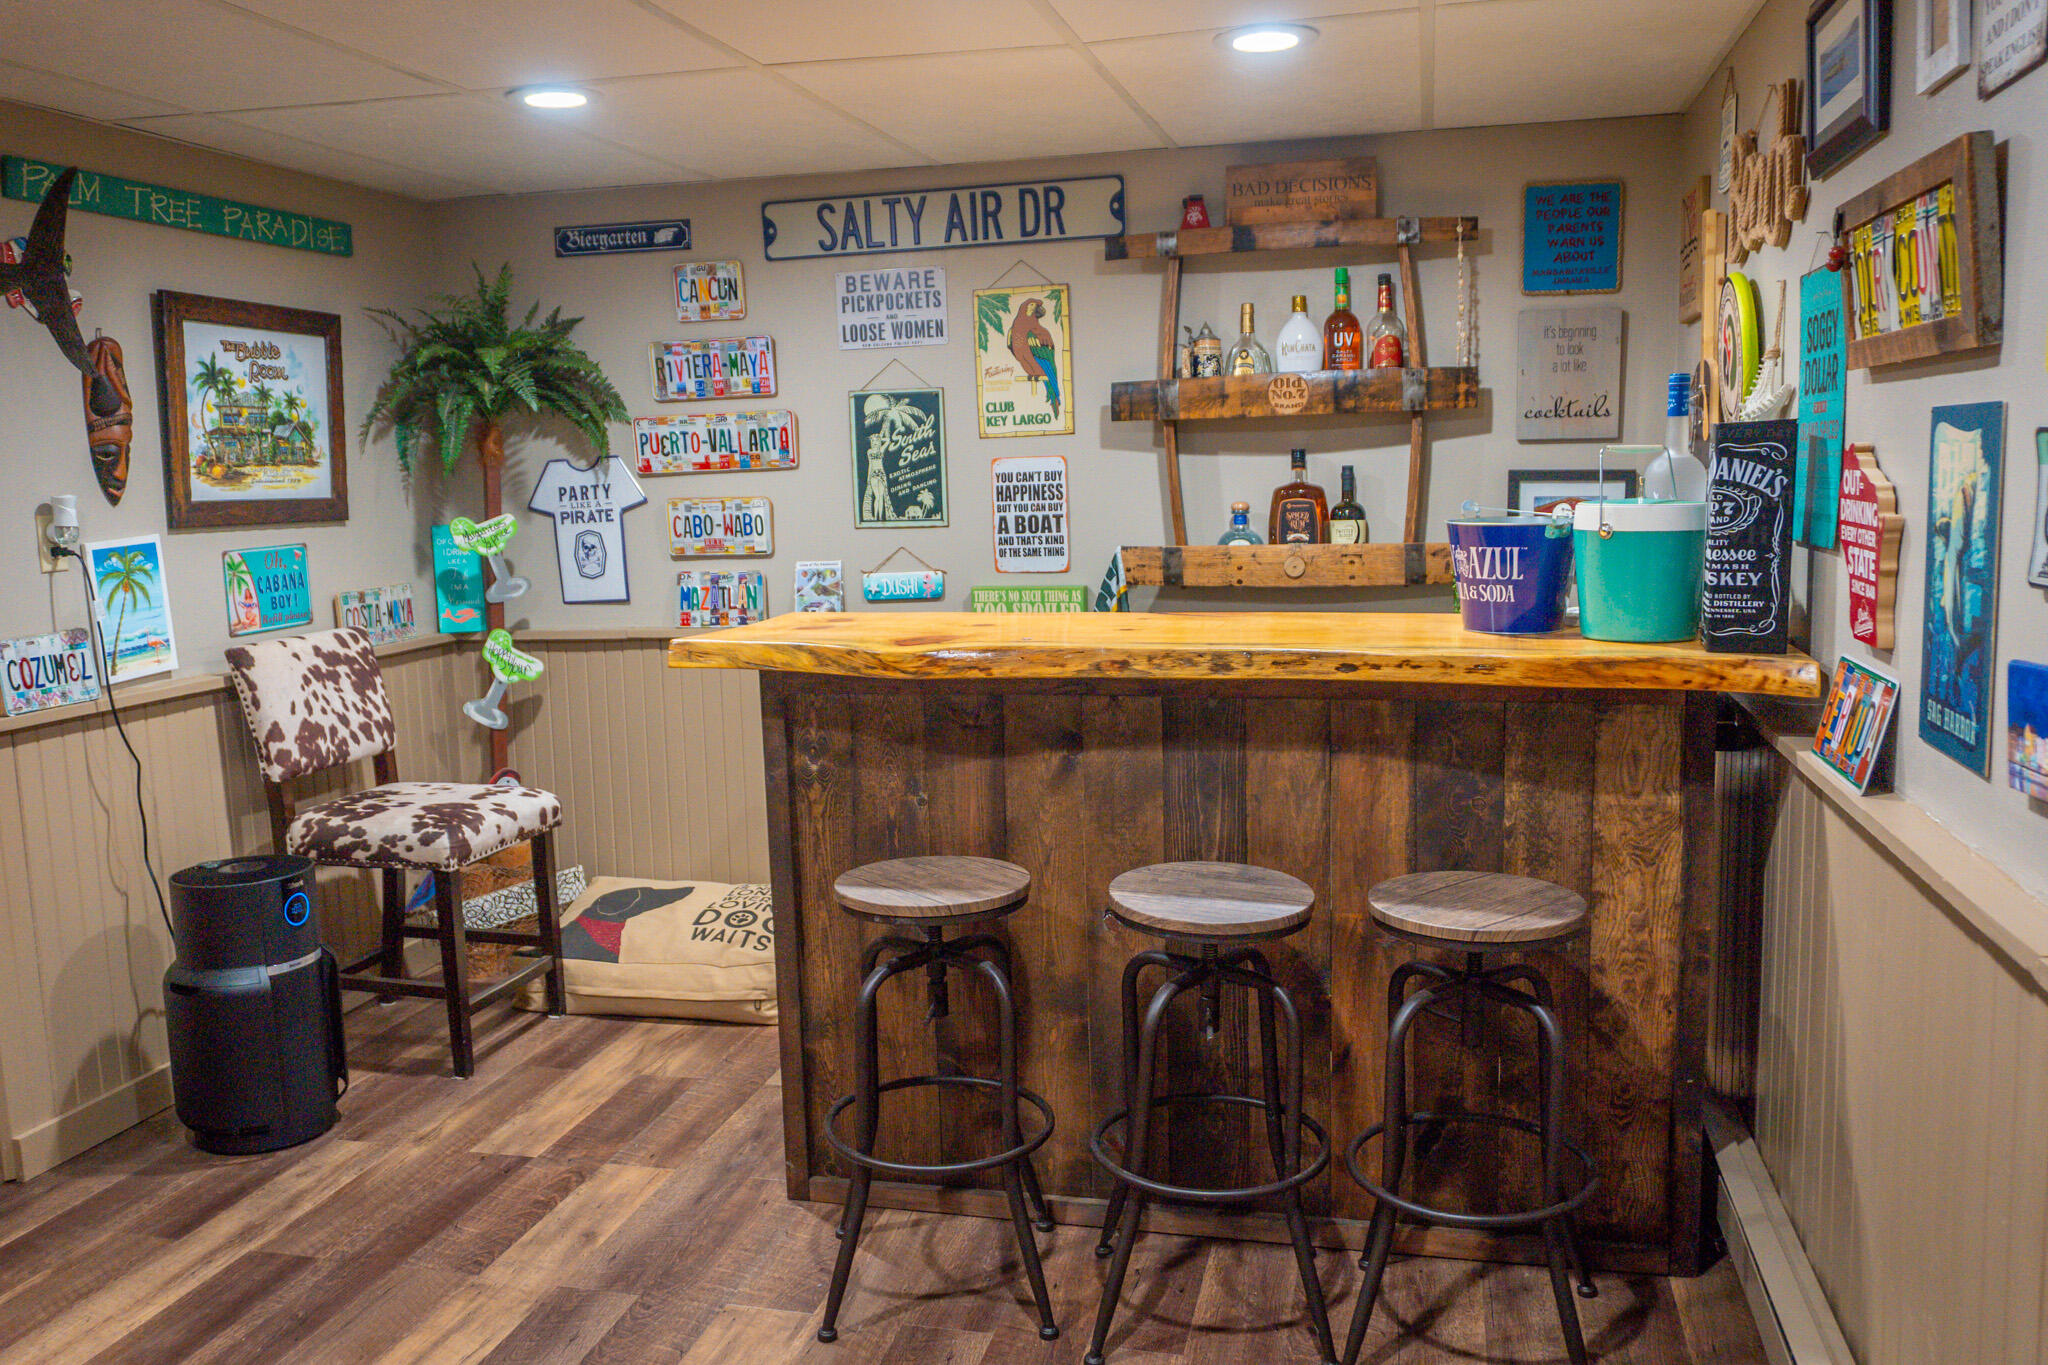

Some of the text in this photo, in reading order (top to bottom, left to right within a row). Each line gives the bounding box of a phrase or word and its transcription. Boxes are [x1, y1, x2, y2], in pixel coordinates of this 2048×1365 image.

[1232, 173, 1373, 198] BAD DECISIONS
[22, 162, 100, 205] PM
[124, 184, 203, 230] TREE
[1560, 192, 1584, 204] ARE
[1589, 190, 1613, 202] THE
[816, 185, 1066, 251] SALTY AIR DR
[1536, 205, 1611, 220] PEOPLE OUR
[1547, 221, 1604, 234] PARENTS
[566, 230, 647, 250] Biergarten
[1547, 235, 1605, 248] WARN US
[1553, 249, 1595, 263] ABOUT
[677, 276, 738, 303] CANCUN
[845, 269, 935, 294] BEWARE
[841, 290, 942, 314] PICKPOCKETS
[842, 319, 944, 343] LOOSE WOMEN
[1334, 331, 1354, 347] UV
[1558, 326, 1598, 341] beginning
[1806, 307, 1839, 354] SOGGY
[234, 340, 281, 363] Bubble
[1273, 377, 1302, 388] Old
[1804, 353, 1839, 396] DOLLAR
[985, 400, 1015, 414] CLUB
[1524, 394, 1611, 419] cocktails
[986, 412, 1052, 427] KEY LARGO
[639, 426, 790, 457] PUERTO-VALLARTA
[889, 413, 936, 451] South
[898, 441, 937, 467] Seas
[898, 464, 937, 481] ATMOSPHERE
[995, 470, 1063, 483] YOU CAN'T BUY
[558, 483, 611, 502] PARTY
[996, 483, 1064, 502] HAPPINESS
[570, 501, 592, 509] LIKE
[997, 502, 1063, 513] BUT YOU CAN BUY
[1839, 497, 1879, 527] DRINKING
[560, 508, 614, 526] PIRATE
[673, 512, 764, 539] CABO-WABO
[997, 514, 1064, 535] A BOAT
[998, 535, 1064, 546] AND THAT'S KIND
[264, 551, 287, 570] Oh,
[999, 546, 1065, 558] OF THE SAME THING
[1468, 546, 1524, 580] AZUL
[1847, 546, 1877, 582] STATE
[257, 571, 305, 595] CABANA
[881, 576, 919, 596] DUSHI
[679, 582, 758, 611] MAZATLAN
[973, 590, 1081, 602] THERE'S NO SUCH THING AS
[1470, 586, 1477, 599] &
[1480, 584, 1515, 603] SODA
[344, 598, 414, 629] COSTA-MAYA
[1713, 600, 1765, 608] DISTILLERY
[262, 612, 283, 625] Refill
[7, 652, 93, 692] COZUMEL
[1927, 698, 1976, 747] SAG HARBOR
[691, 927, 771, 951] WAITS
